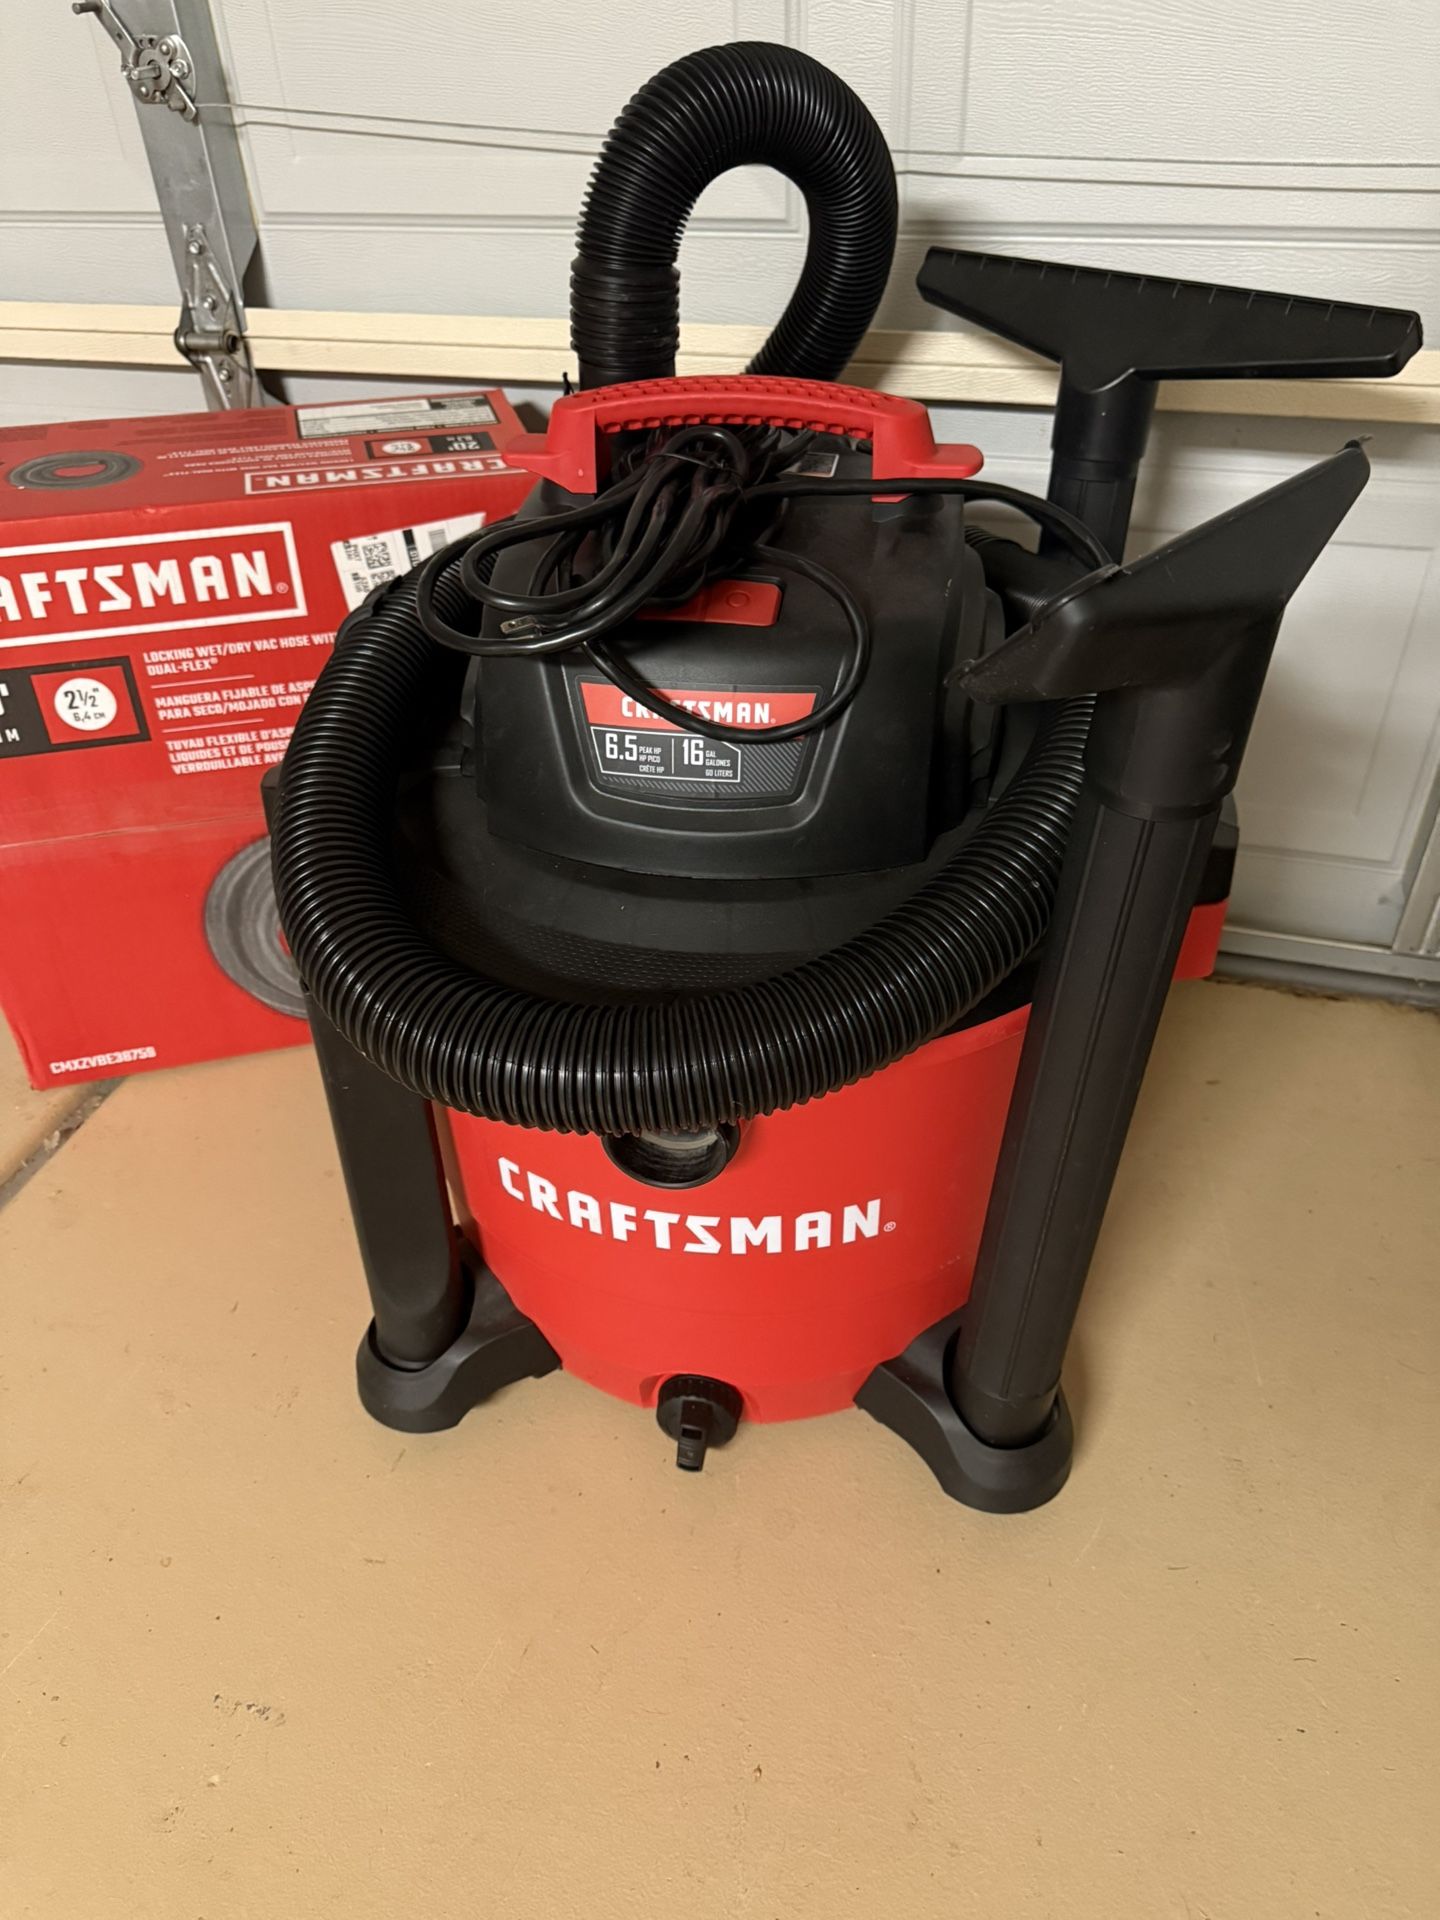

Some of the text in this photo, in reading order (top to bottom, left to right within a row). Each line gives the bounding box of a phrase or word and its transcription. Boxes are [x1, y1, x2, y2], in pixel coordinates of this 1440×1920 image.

[143, 631, 338, 663] LOCKING WET/DRY VAC HOSE WIT
[155, 690, 221, 708] MANGUERA
[222, 684, 270, 701] FIJABLE
[271, 683, 287, 695] DE
[158, 706, 192, 721] PARA
[193, 696, 277, 716] SECO/MOJADO
[277, 694, 302, 707] CON
[166, 738, 205, 752] TUYAU
[206, 730, 259, 747] FLEXIBLE
[604, 732, 638, 761] 6.5
[639, 746, 662, 755] PEAK HP
[169, 747, 222, 763] LIQUIDES
[222, 745, 236, 757] ET
[239, 743, 255, 755] DE
[639, 754, 661, 763] HP PICO
[683, 738, 704, 766] 16
[172, 754, 263, 775] VERROUILLABLE
[639, 764, 665, 774] CRÊTE HP
[705, 759, 731, 767] GALONES
[705, 769, 733, 778] 60 LITERS
